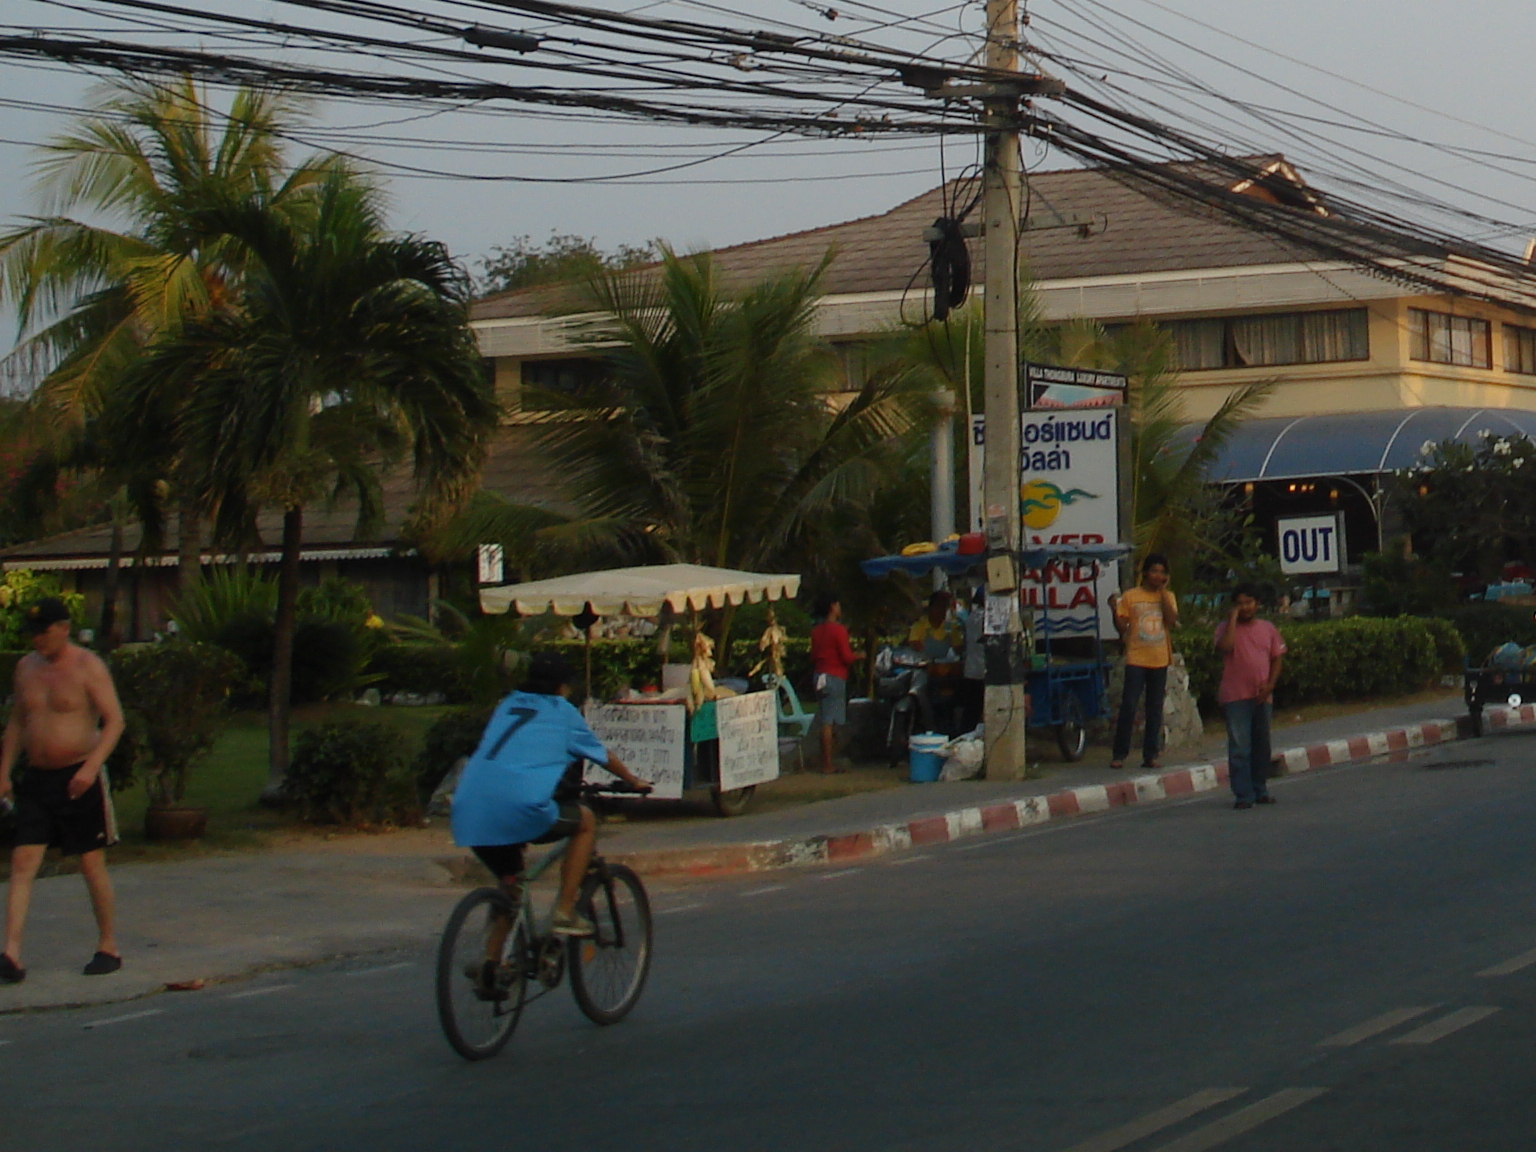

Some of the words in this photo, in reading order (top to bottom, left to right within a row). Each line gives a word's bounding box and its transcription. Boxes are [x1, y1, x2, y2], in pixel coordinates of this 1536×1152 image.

[1283, 527, 1333, 563] OUT
[1021, 585, 1097, 610] ILLA
[485, 707, 538, 760] 7
